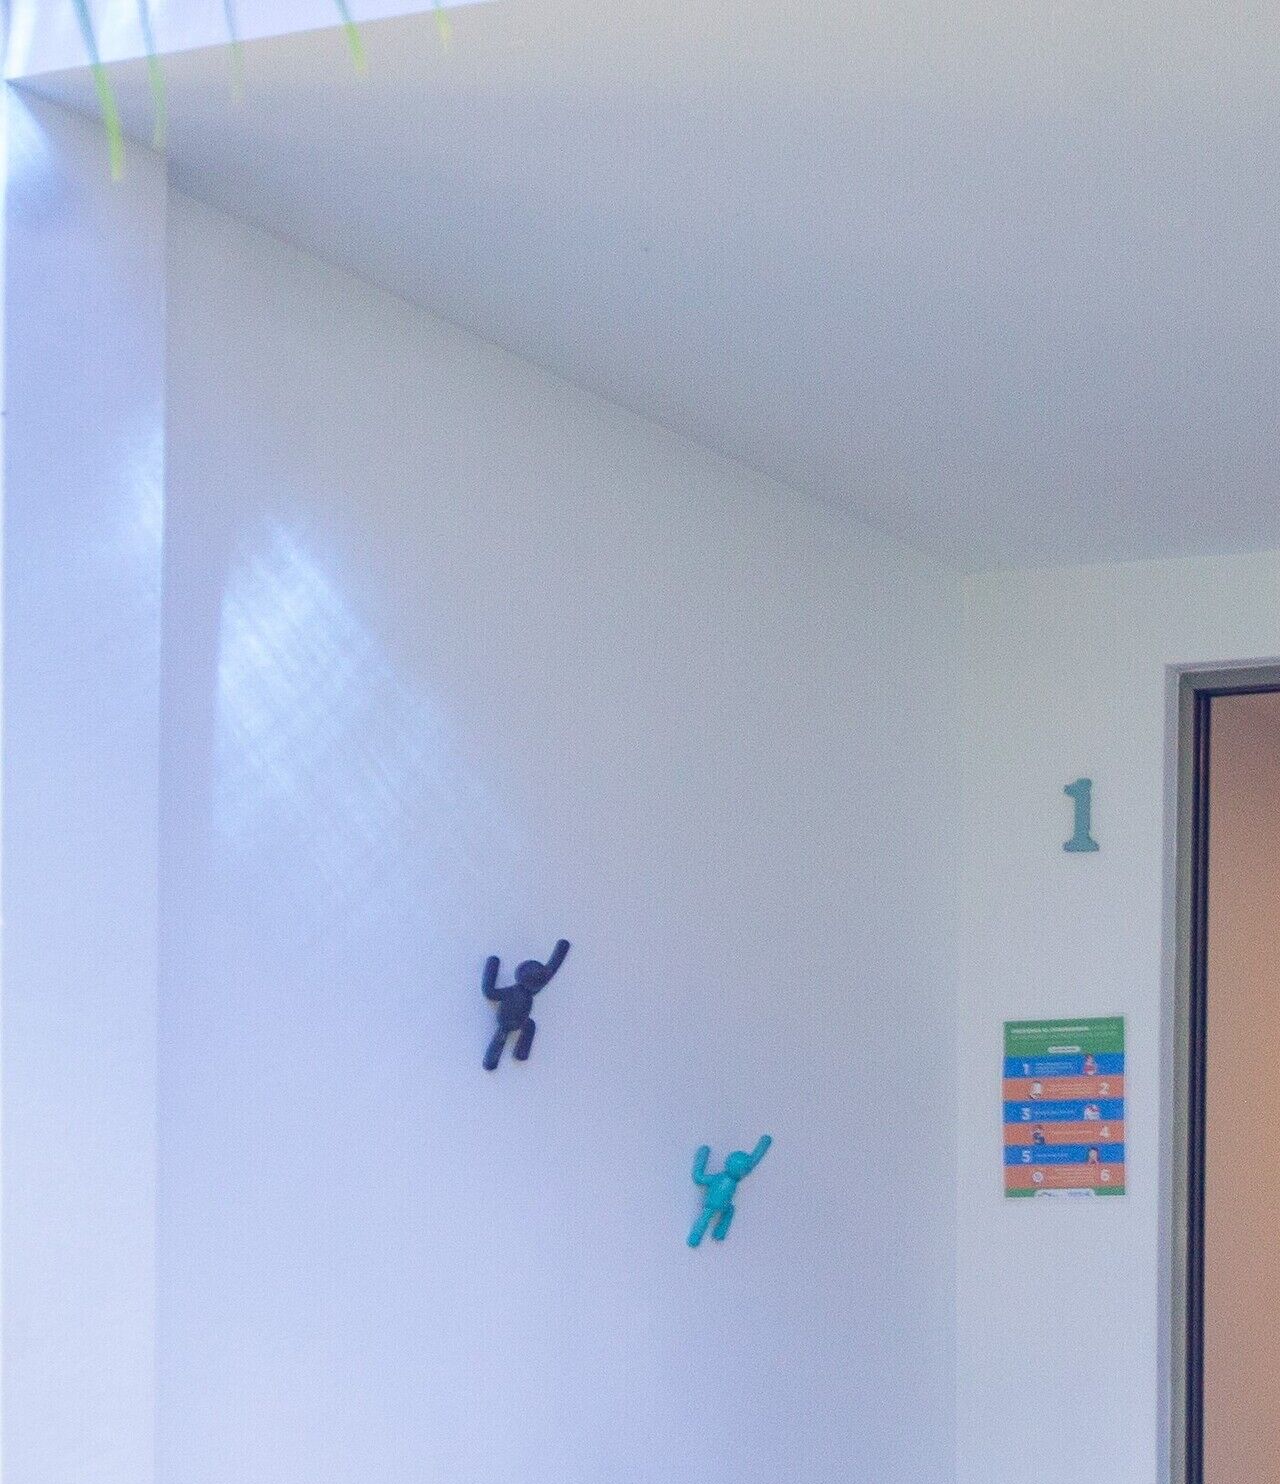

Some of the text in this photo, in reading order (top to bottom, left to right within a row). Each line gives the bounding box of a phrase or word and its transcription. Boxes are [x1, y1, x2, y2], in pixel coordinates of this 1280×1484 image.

[1063, 777, 1099, 853] 1
[1099, 1082, 1109, 1095] 2
[1021, 1150, 1031, 1163] 5
